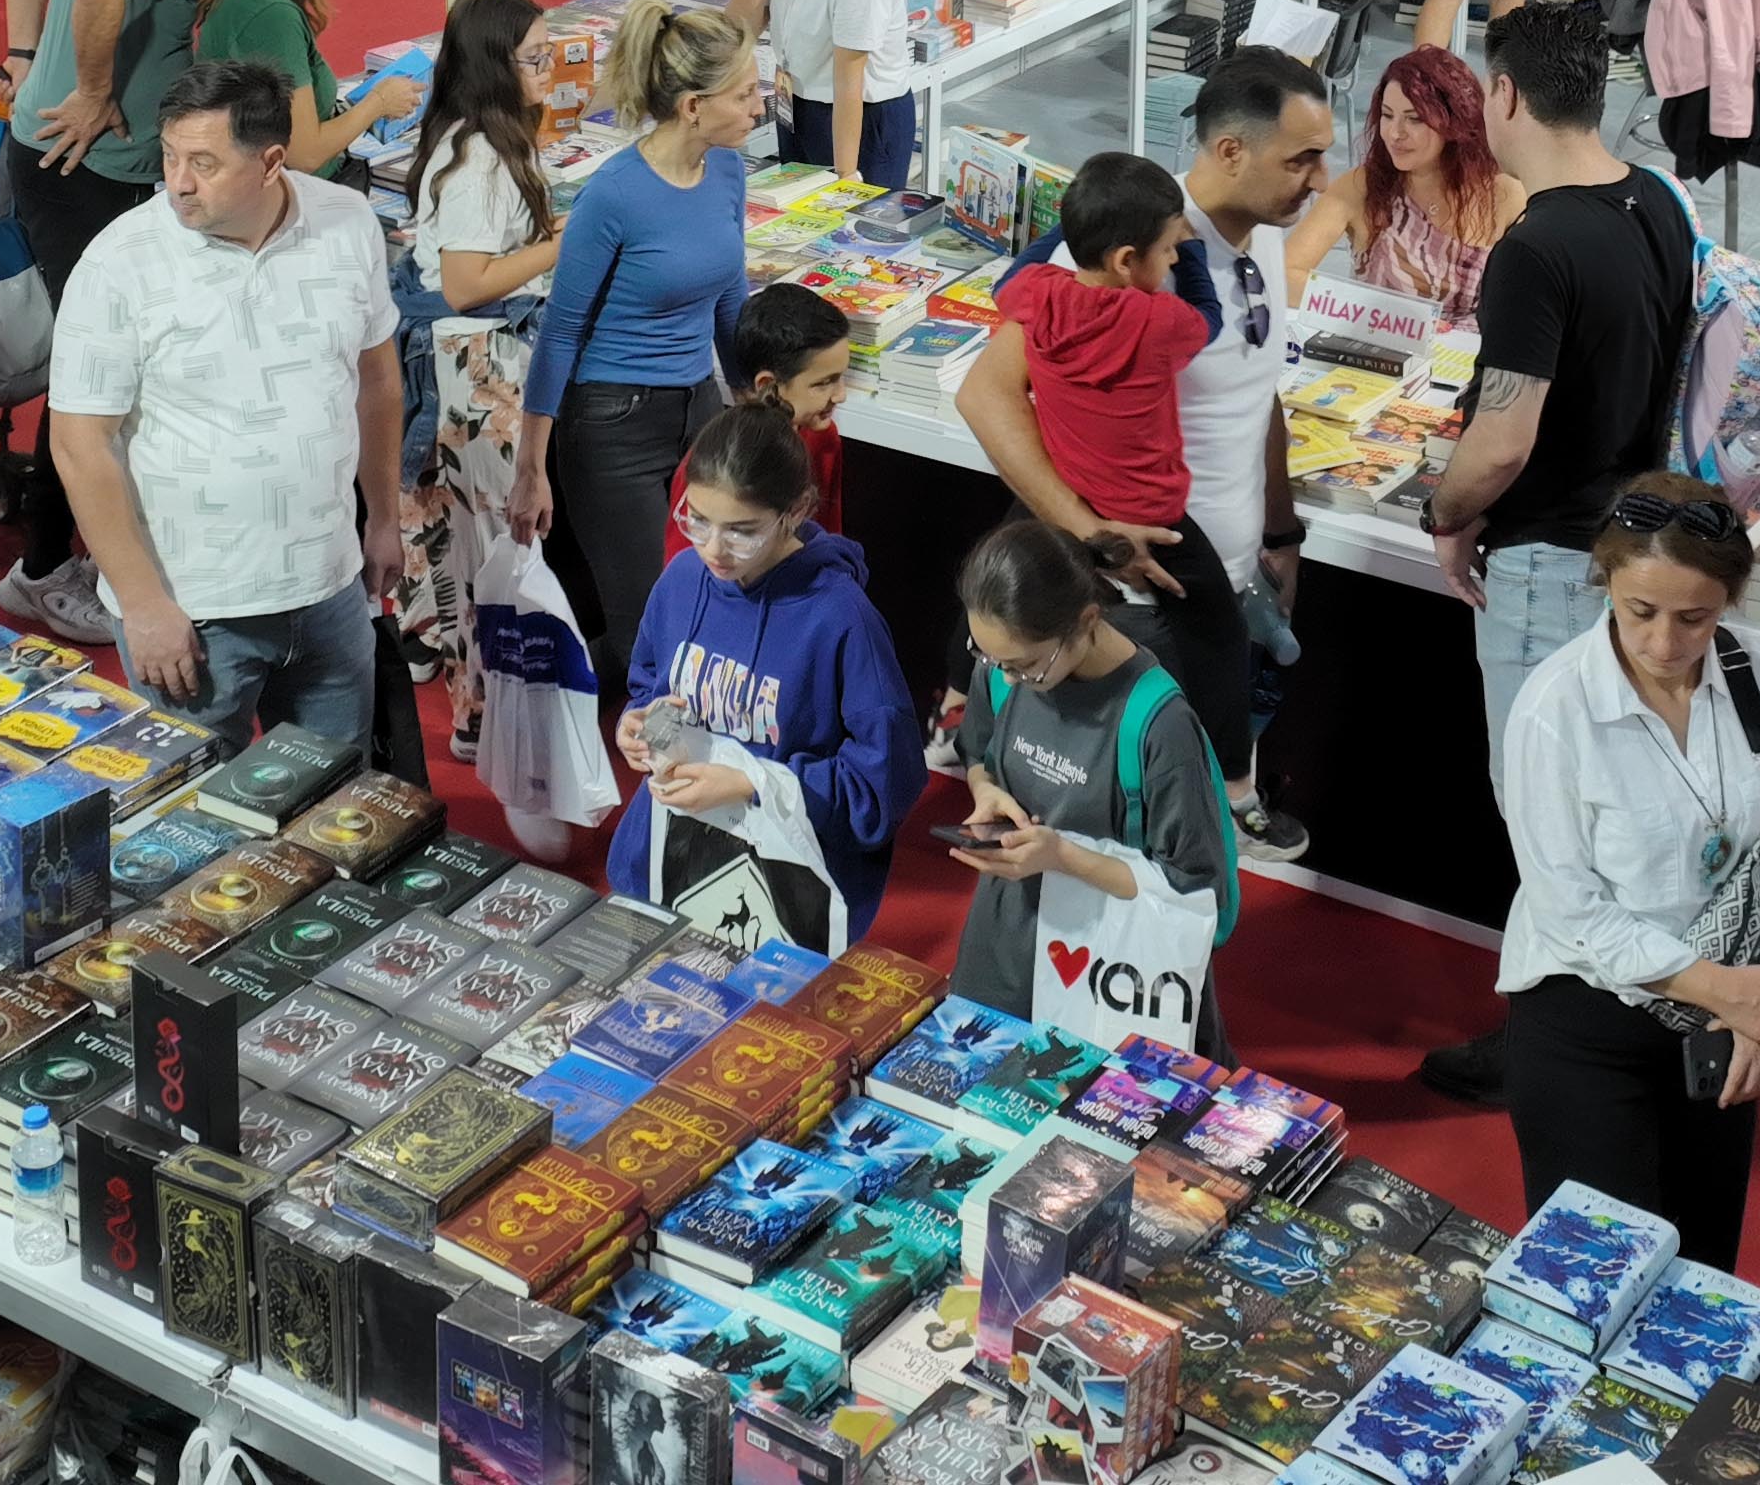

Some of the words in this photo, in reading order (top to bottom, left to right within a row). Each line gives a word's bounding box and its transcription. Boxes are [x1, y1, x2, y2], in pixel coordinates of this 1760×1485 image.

[1307, 289, 1365, 324] NİLAY
[1368, 308, 1426, 341] ŞANLI
[91, 746, 138, 768] ALTINDA
[1013, 735, 1035, 757] New
[1035, 745, 1056, 768] York
[1056, 755, 1088, 786] Lifestyle
[156, 821, 220, 855] PUSULA
[237, 850, 302, 885] PUSULA
[424, 844, 489, 878] PUSULA
[317, 893, 383, 929] PUSULA
[678, 1215, 756, 1250] PANDORA
[769, 1277, 847, 1320] PANDORA
[1292, 1311, 1376, 1358] LORESİMA
[897, 1427, 994, 1480] RUHLAR
[922, 1414, 1003, 1461] SARAYI
